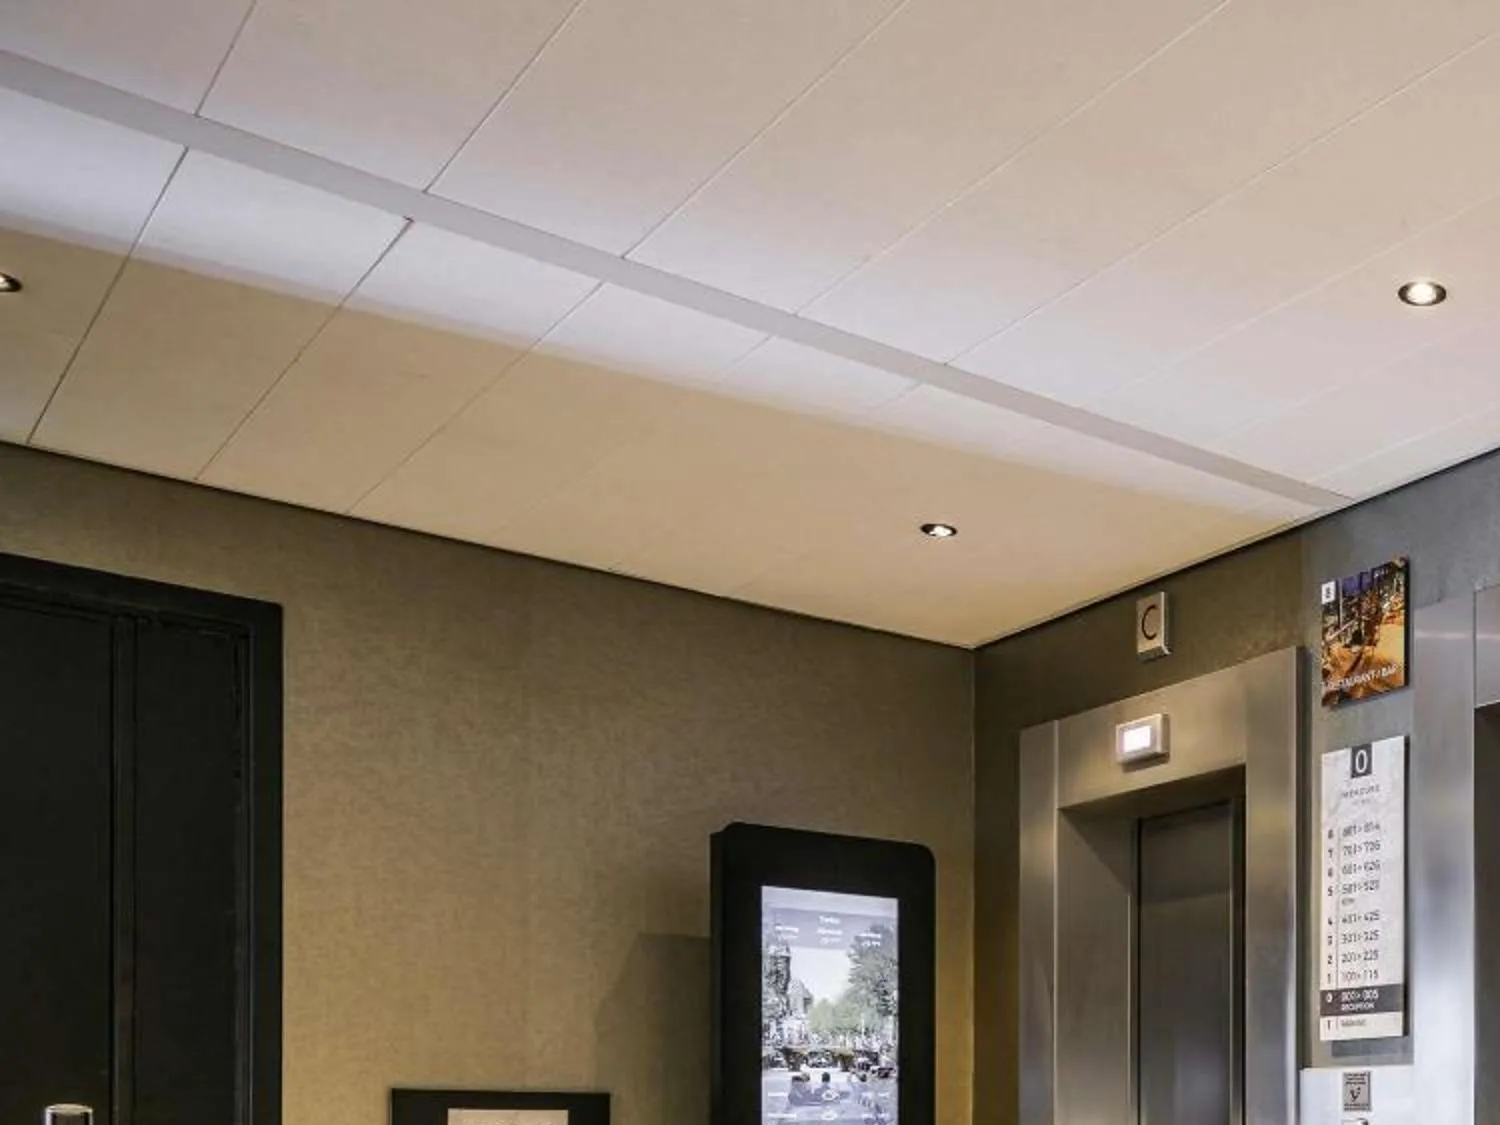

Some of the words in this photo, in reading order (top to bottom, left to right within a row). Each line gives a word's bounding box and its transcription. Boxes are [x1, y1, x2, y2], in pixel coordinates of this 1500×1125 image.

[1141, 603, 1157, 641] C
[1327, 954, 1333, 965] 2
[1326, 992, 1333, 1003] 0
